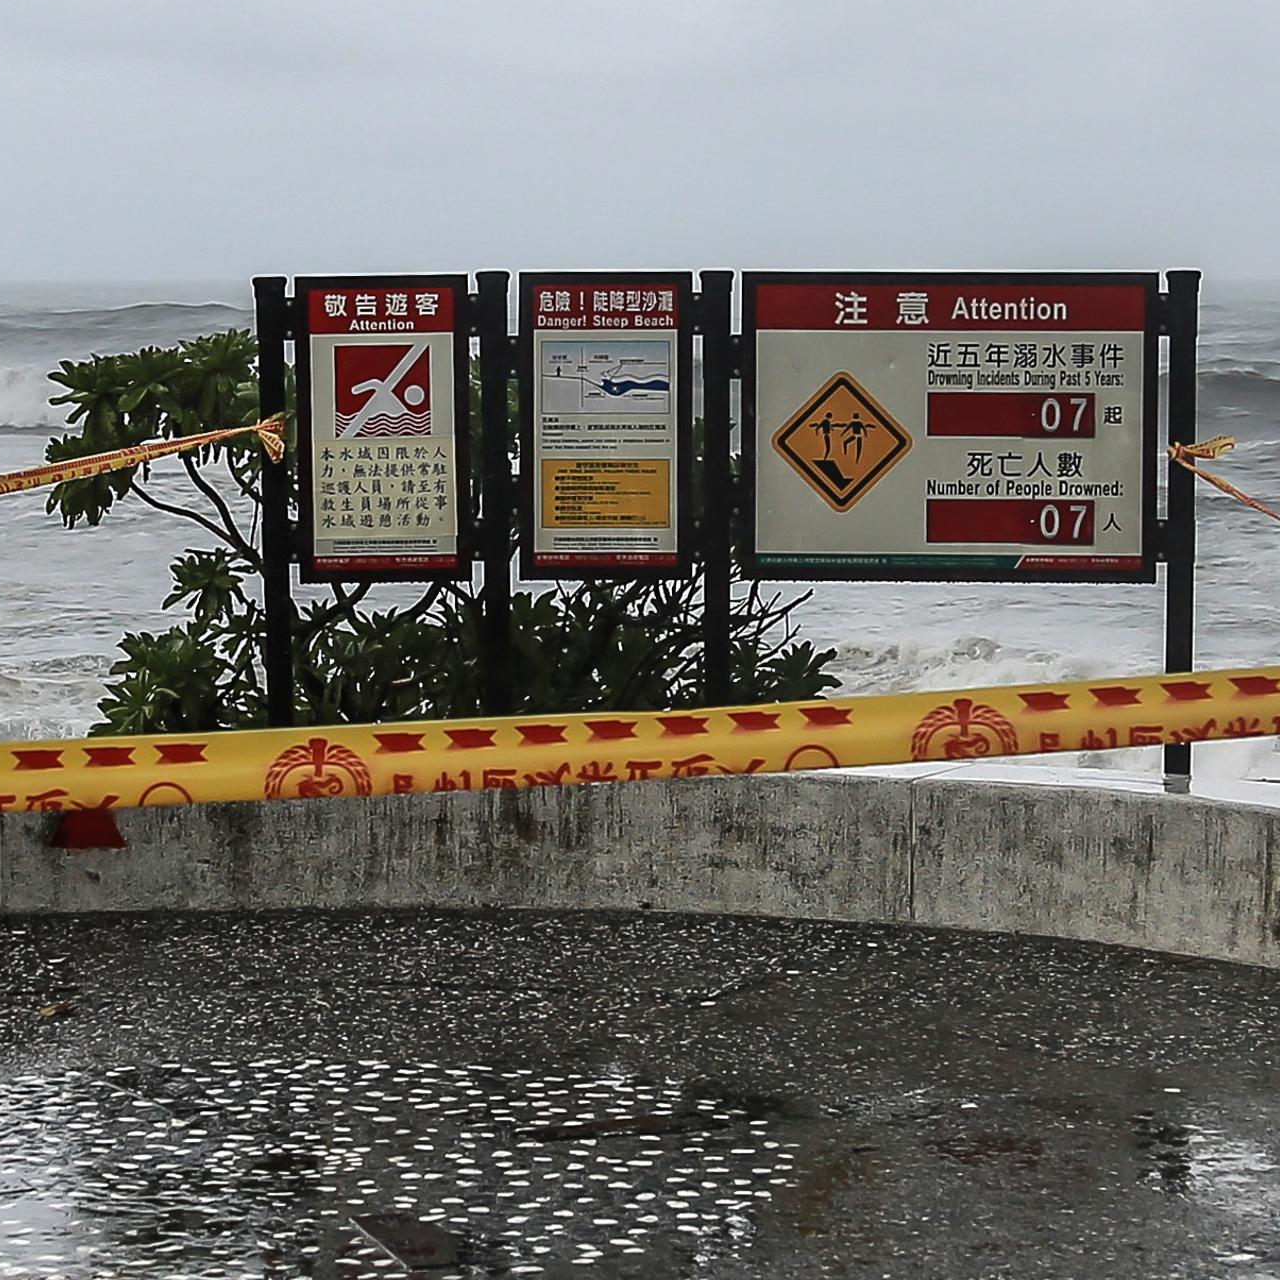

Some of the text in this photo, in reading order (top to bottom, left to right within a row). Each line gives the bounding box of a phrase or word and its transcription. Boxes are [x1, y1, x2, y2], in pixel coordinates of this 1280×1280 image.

[324, 293, 439, 317] 敬告遊客
[833, 291, 1068, 326] 注意 Attention
[349, 319, 415, 331] Attention
[537, 314, 674, 330] Danger! Steep Beach
[927, 343, 1124, 369] 近五年溺水事件
[928, 370, 1124, 389] Drowning Incidents During Past 5 Years:
[1041, 397, 1123, 433] 07 起
[966, 452, 1083, 478] 死亡人數
[926, 480, 1124, 499] Number of People Drowned:
[1039, 505, 1123, 540] 07 人
